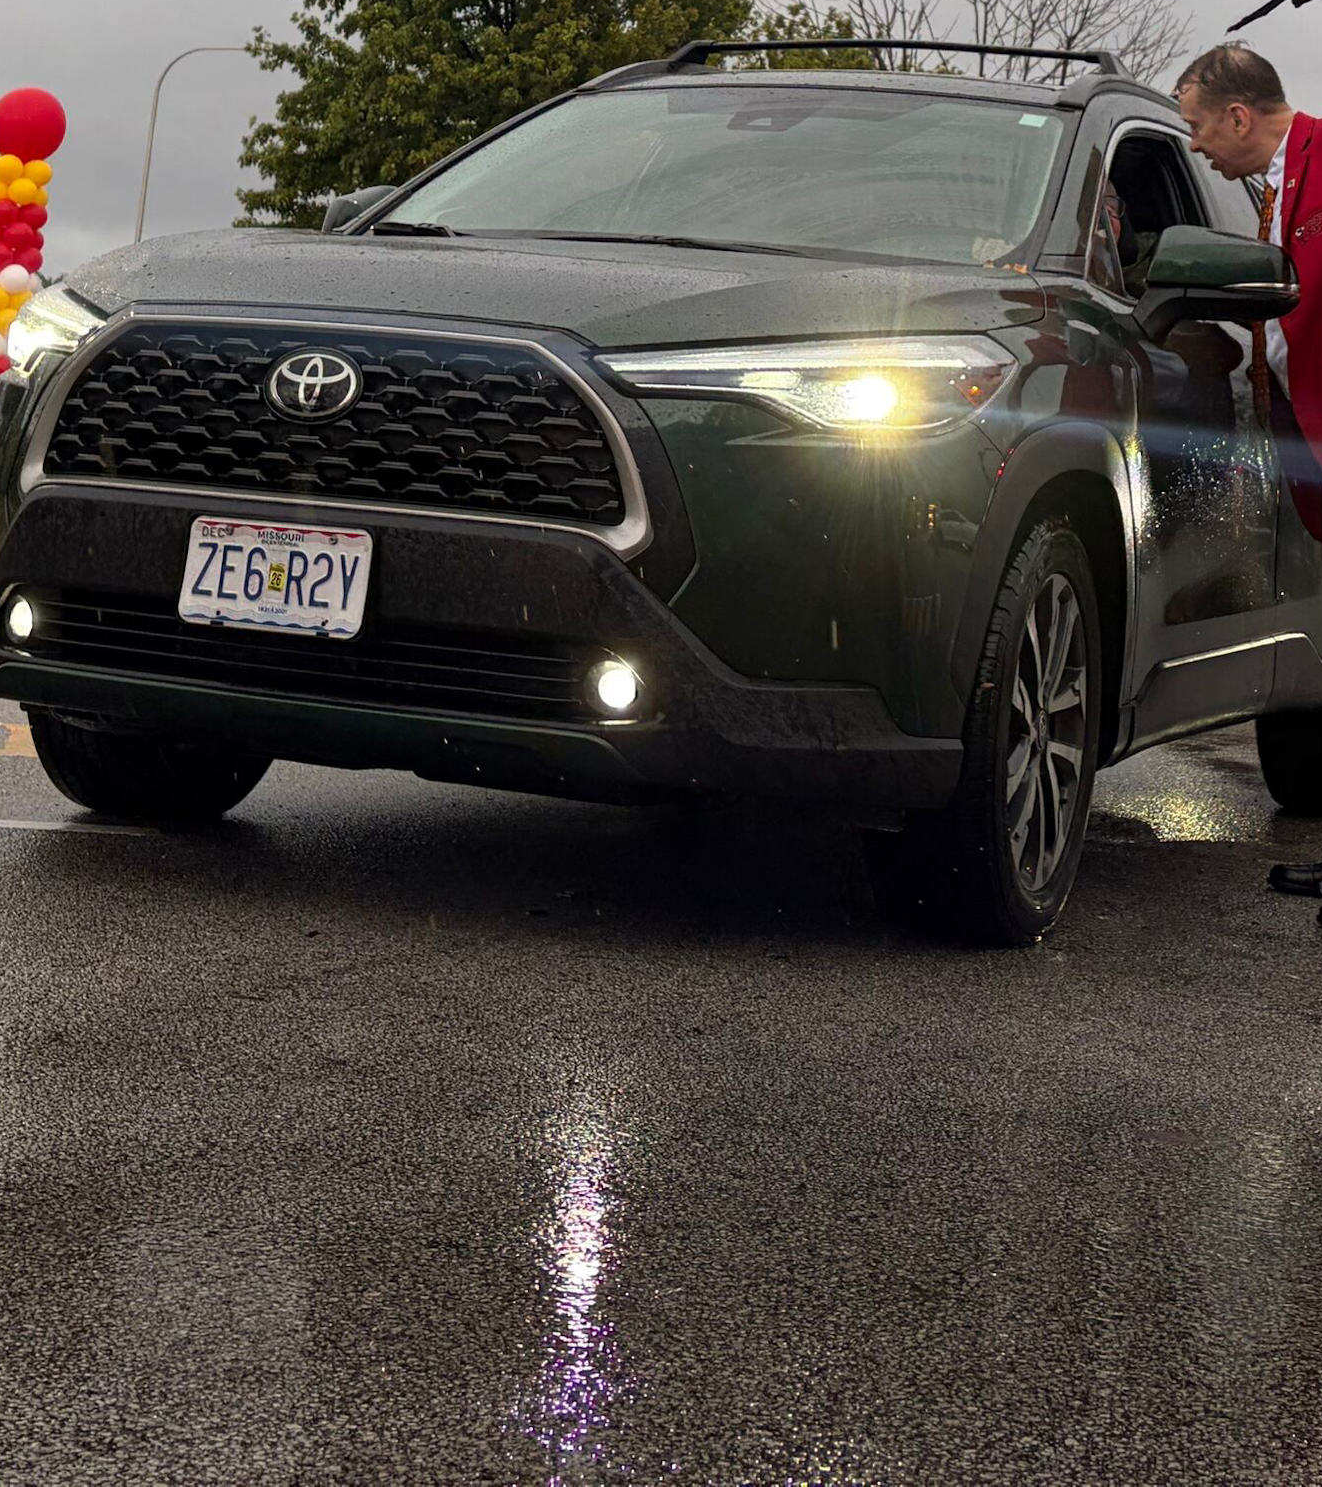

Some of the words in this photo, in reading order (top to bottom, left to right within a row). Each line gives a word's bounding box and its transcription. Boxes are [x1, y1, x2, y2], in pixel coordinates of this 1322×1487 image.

[202, 525, 225, 538] DEC
[257, 530, 305, 543] MISSOURI
[191, 541, 267, 602] ZE6
[284, 550, 360, 611] R2Y
[270, 572, 283, 586] 26
